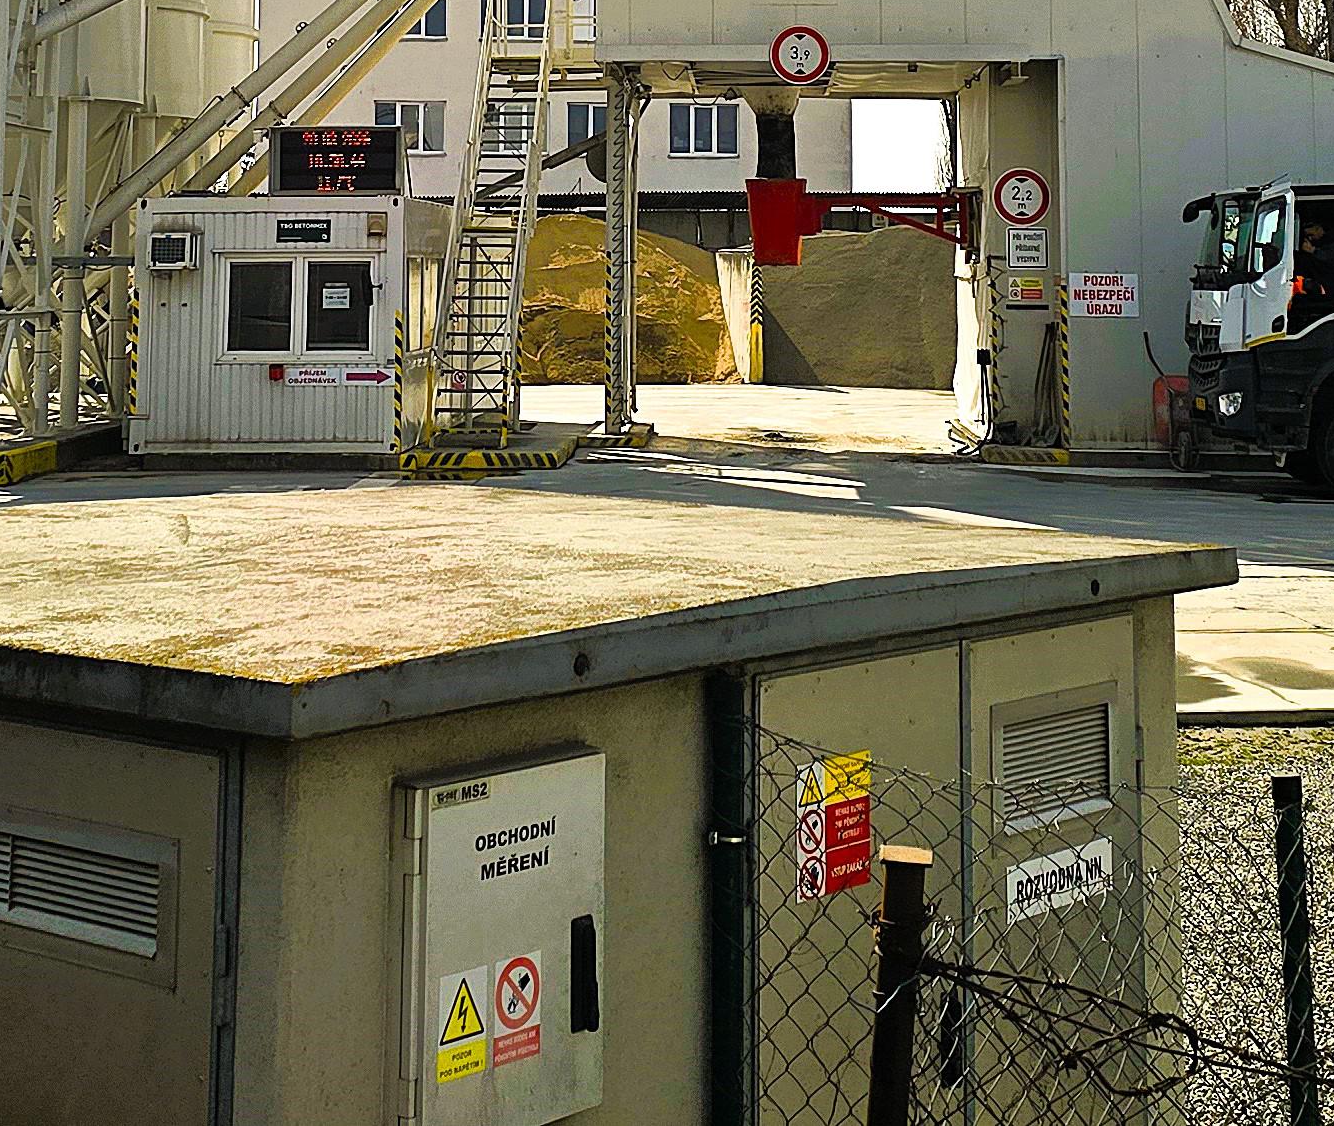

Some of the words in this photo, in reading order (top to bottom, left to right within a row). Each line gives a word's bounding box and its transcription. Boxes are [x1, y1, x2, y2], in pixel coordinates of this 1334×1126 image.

[1017, 202, 1027, 210] m
[1083, 275, 1124, 287] POZOR!
[1073, 286, 1136, 302] NEBEZPEČÍ
[1086, 301, 1123, 315] ÚRAZU
[298, 369, 327, 377] PŘÍJEM
[461, 782, 488, 801] MS2
[475, 815, 556, 852] OBCHODNÍ
[480, 845, 550, 881] MĚŘENÍ
[1016, 862, 1083, 901] ROZVODNA
[451, 1049, 472, 1062] POZOR
